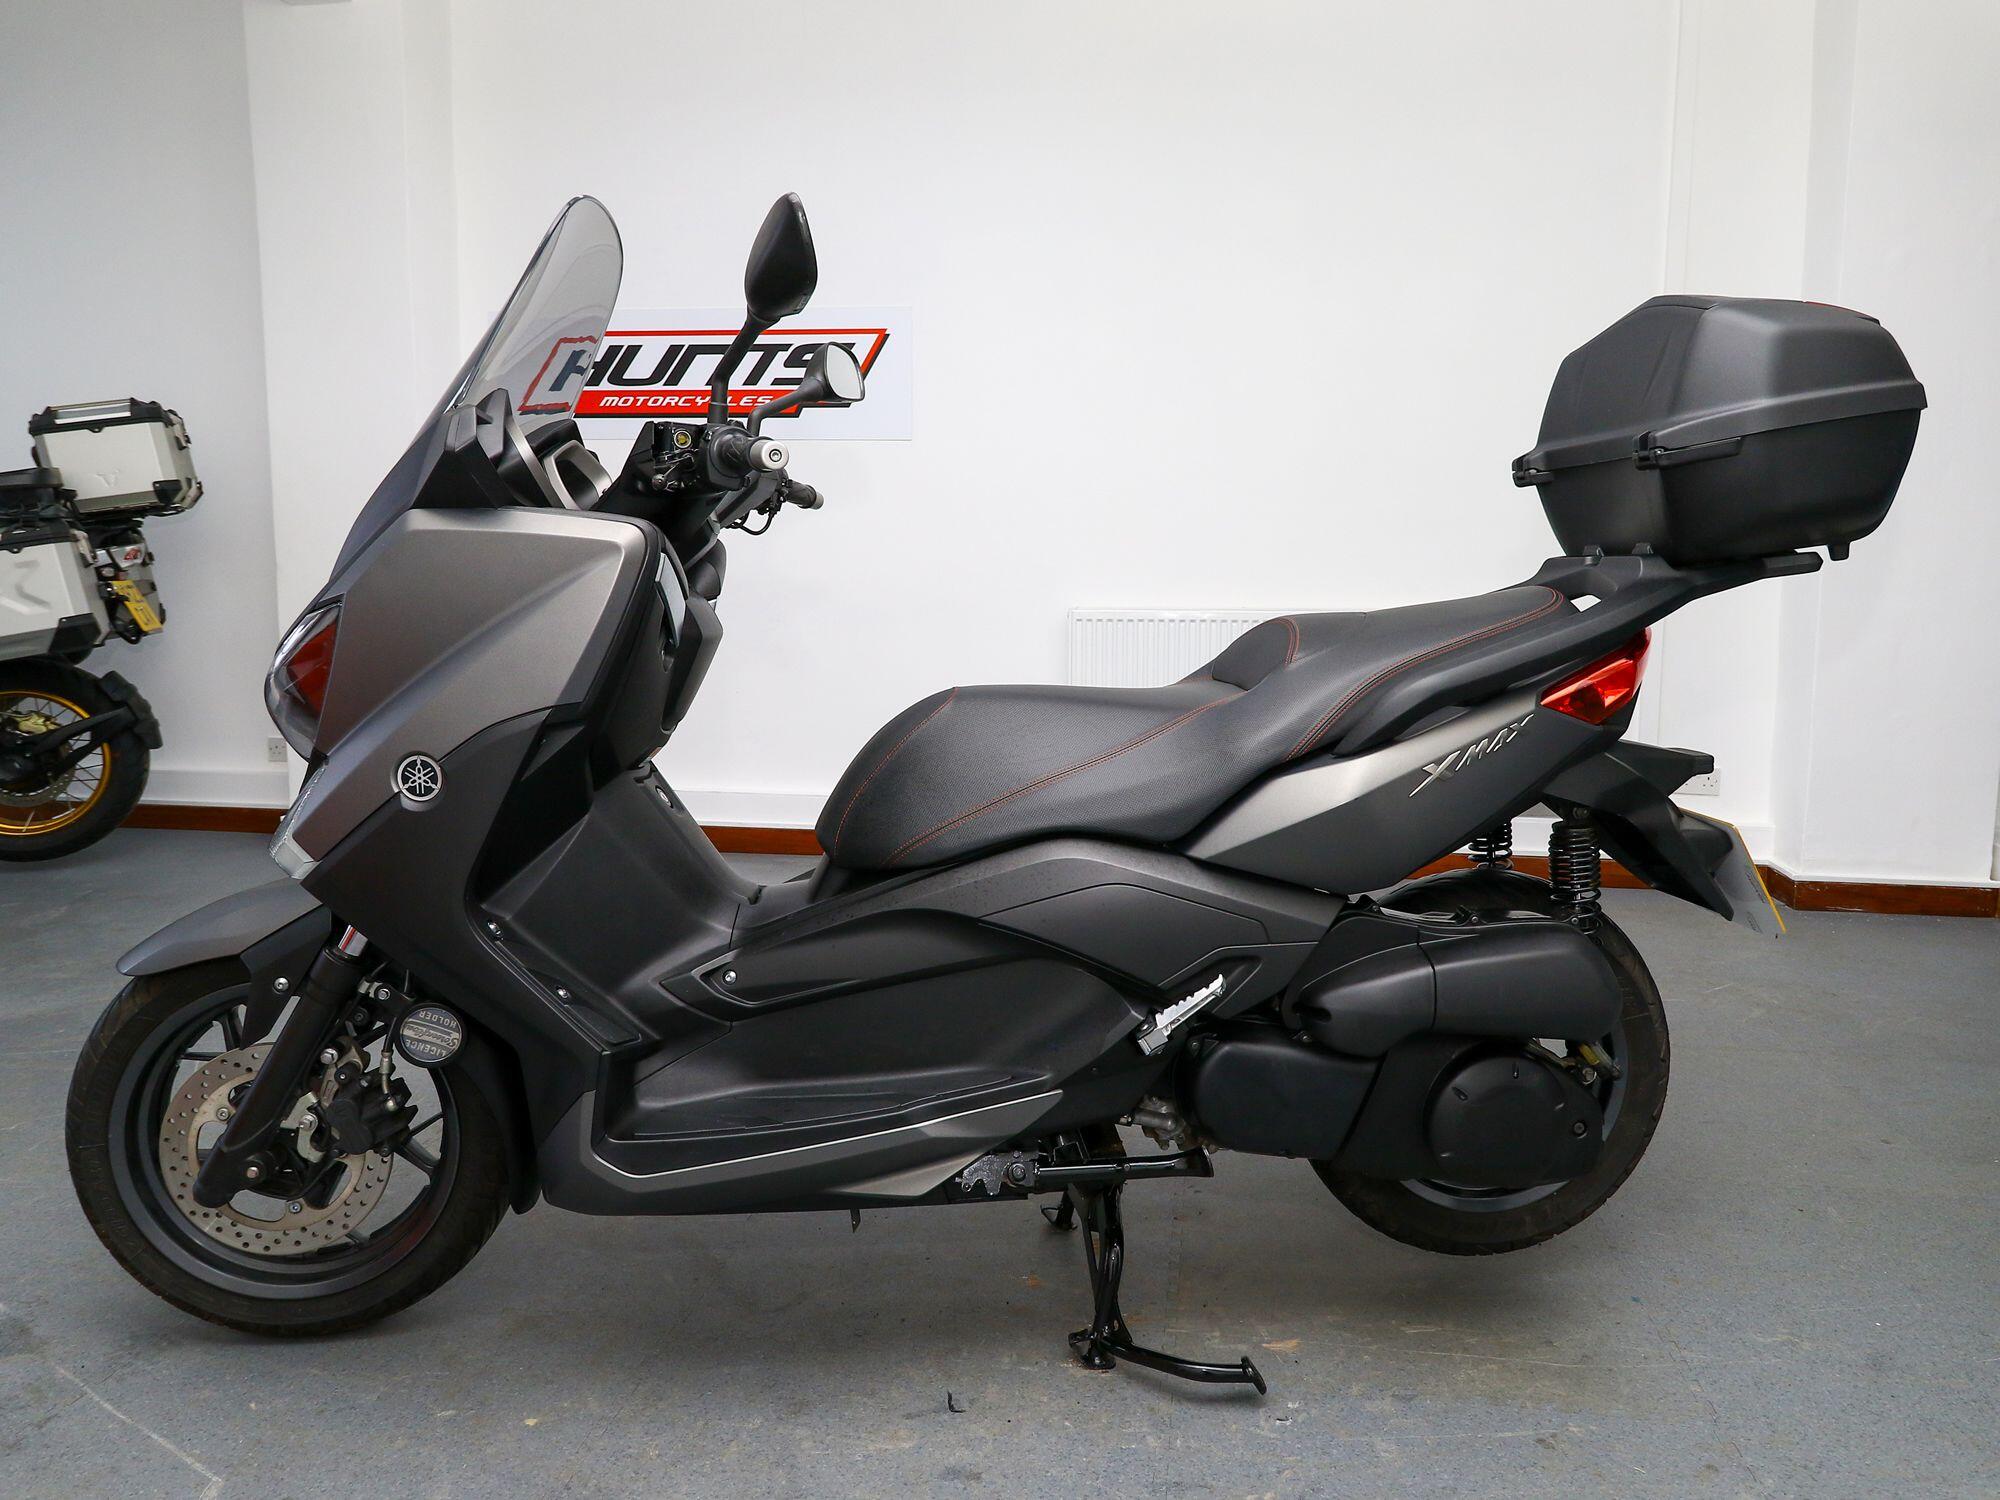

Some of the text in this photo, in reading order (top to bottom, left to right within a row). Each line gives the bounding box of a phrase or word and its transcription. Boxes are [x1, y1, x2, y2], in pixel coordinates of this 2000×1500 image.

[600, 395, 773, 407] MOTORCYLES
[419, 1010, 456, 1029] HOLDER
[405, 1039, 446, 1057] LICENCE
